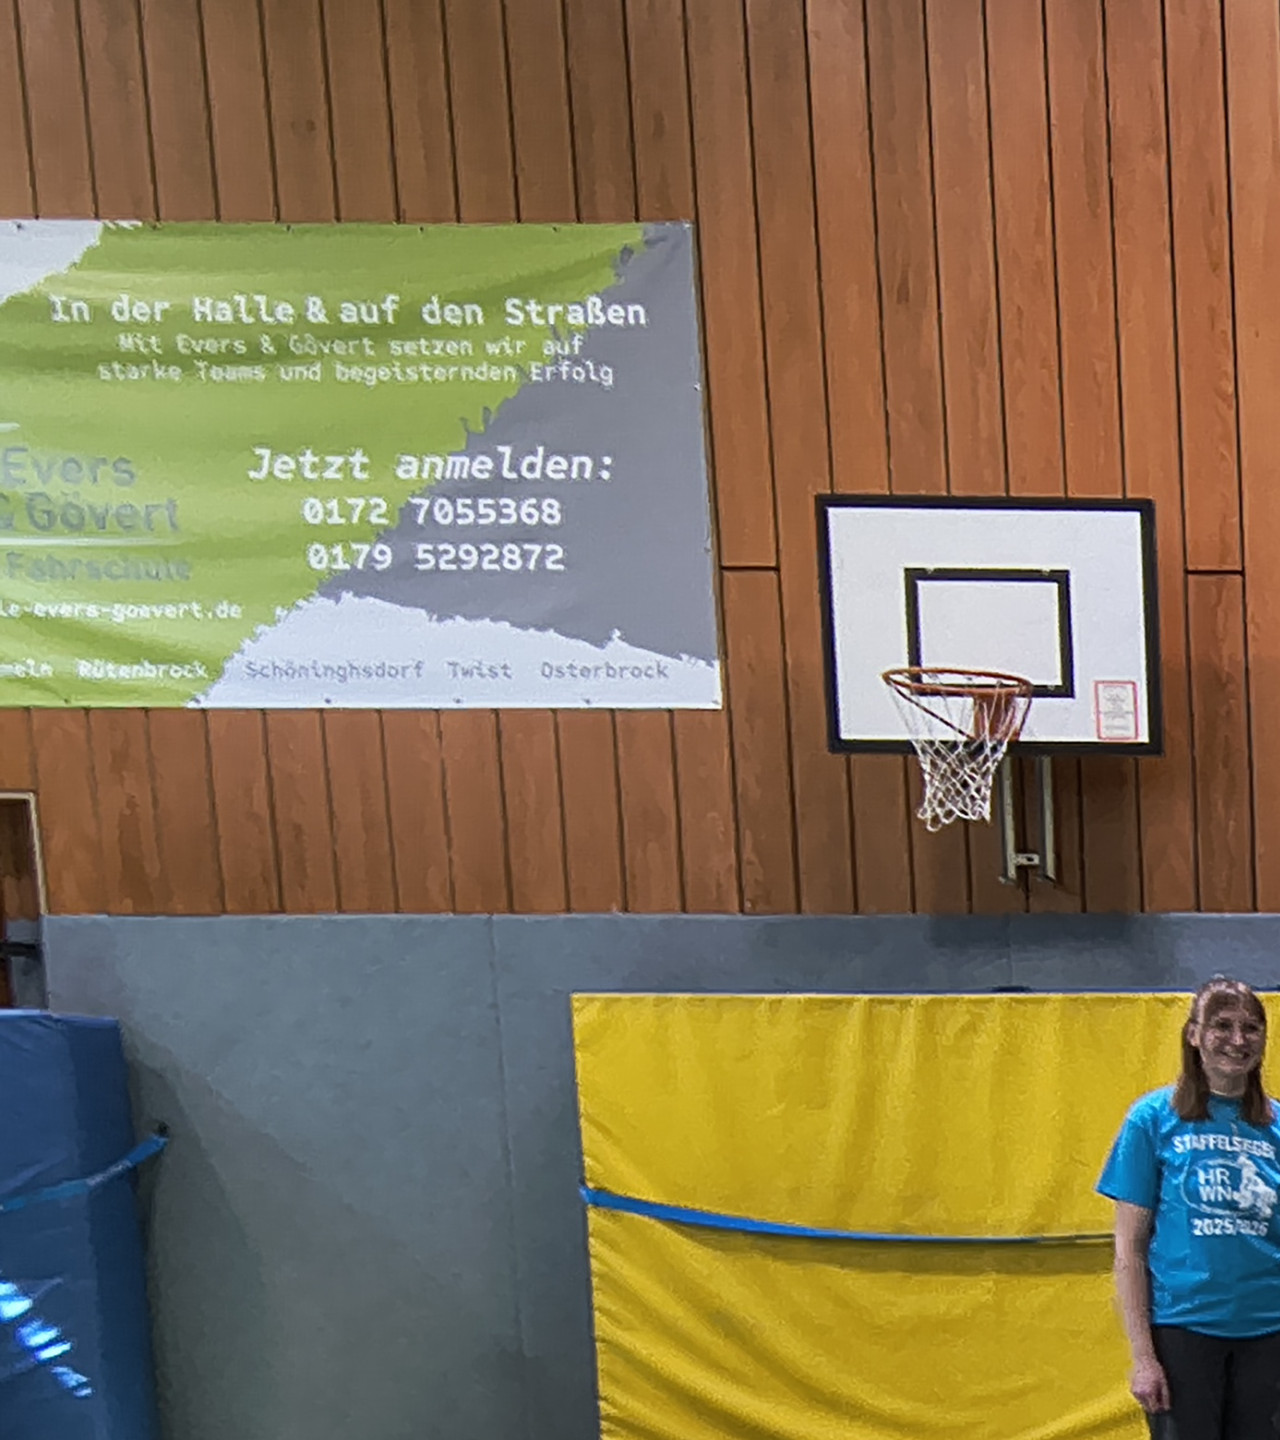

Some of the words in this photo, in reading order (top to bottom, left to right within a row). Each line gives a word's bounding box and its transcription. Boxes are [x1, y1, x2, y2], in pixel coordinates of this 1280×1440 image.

[50, 295, 91, 322] In
[111, 294, 170, 322] der
[193, 294, 295, 324] Halle
[305, 296, 329, 323] &
[340, 295, 400, 323] auf
[421, 295, 485, 325] den
[505, 296, 647, 326] Straßen
[118, 334, 163, 355] Mit
[175, 334, 248, 355] Evers
[259, 334, 276, 354] &
[287, 333, 376, 356] Gövert
[389, 338, 473, 357] setzen
[485, 336, 527, 356] wir
[542, 335, 585, 356] auf
[98, 361, 183, 381] starke
[195, 360, 267, 382] Teams
[280, 361, 322, 382] und
[335, 361, 517, 389] begeisternden
[530, 361, 614, 390] Erfolg
[3, 447, 136, 487] Evers
[248, 447, 370, 481] Jetzt
[395, 445, 614, 480] anmelden:
[25, 491, 180, 532] Gövert
[303, 497, 389, 526] 0172
[412, 497, 563, 526] 7055368
[6, 551, 191, 582] Fahrschule
[308, 543, 393, 571] 0179
[415, 543, 566, 571] 5292872
[76, 659, 209, 679] Rütenbrock
[245, 660, 425, 681] Schöninghsdorf
[447, 660, 513, 680] Twist
[541, 660, 669, 680] Osterbrock
[1197, 1167, 1231, 1185] HR
[1198, 1185, 1232, 1202] WN
